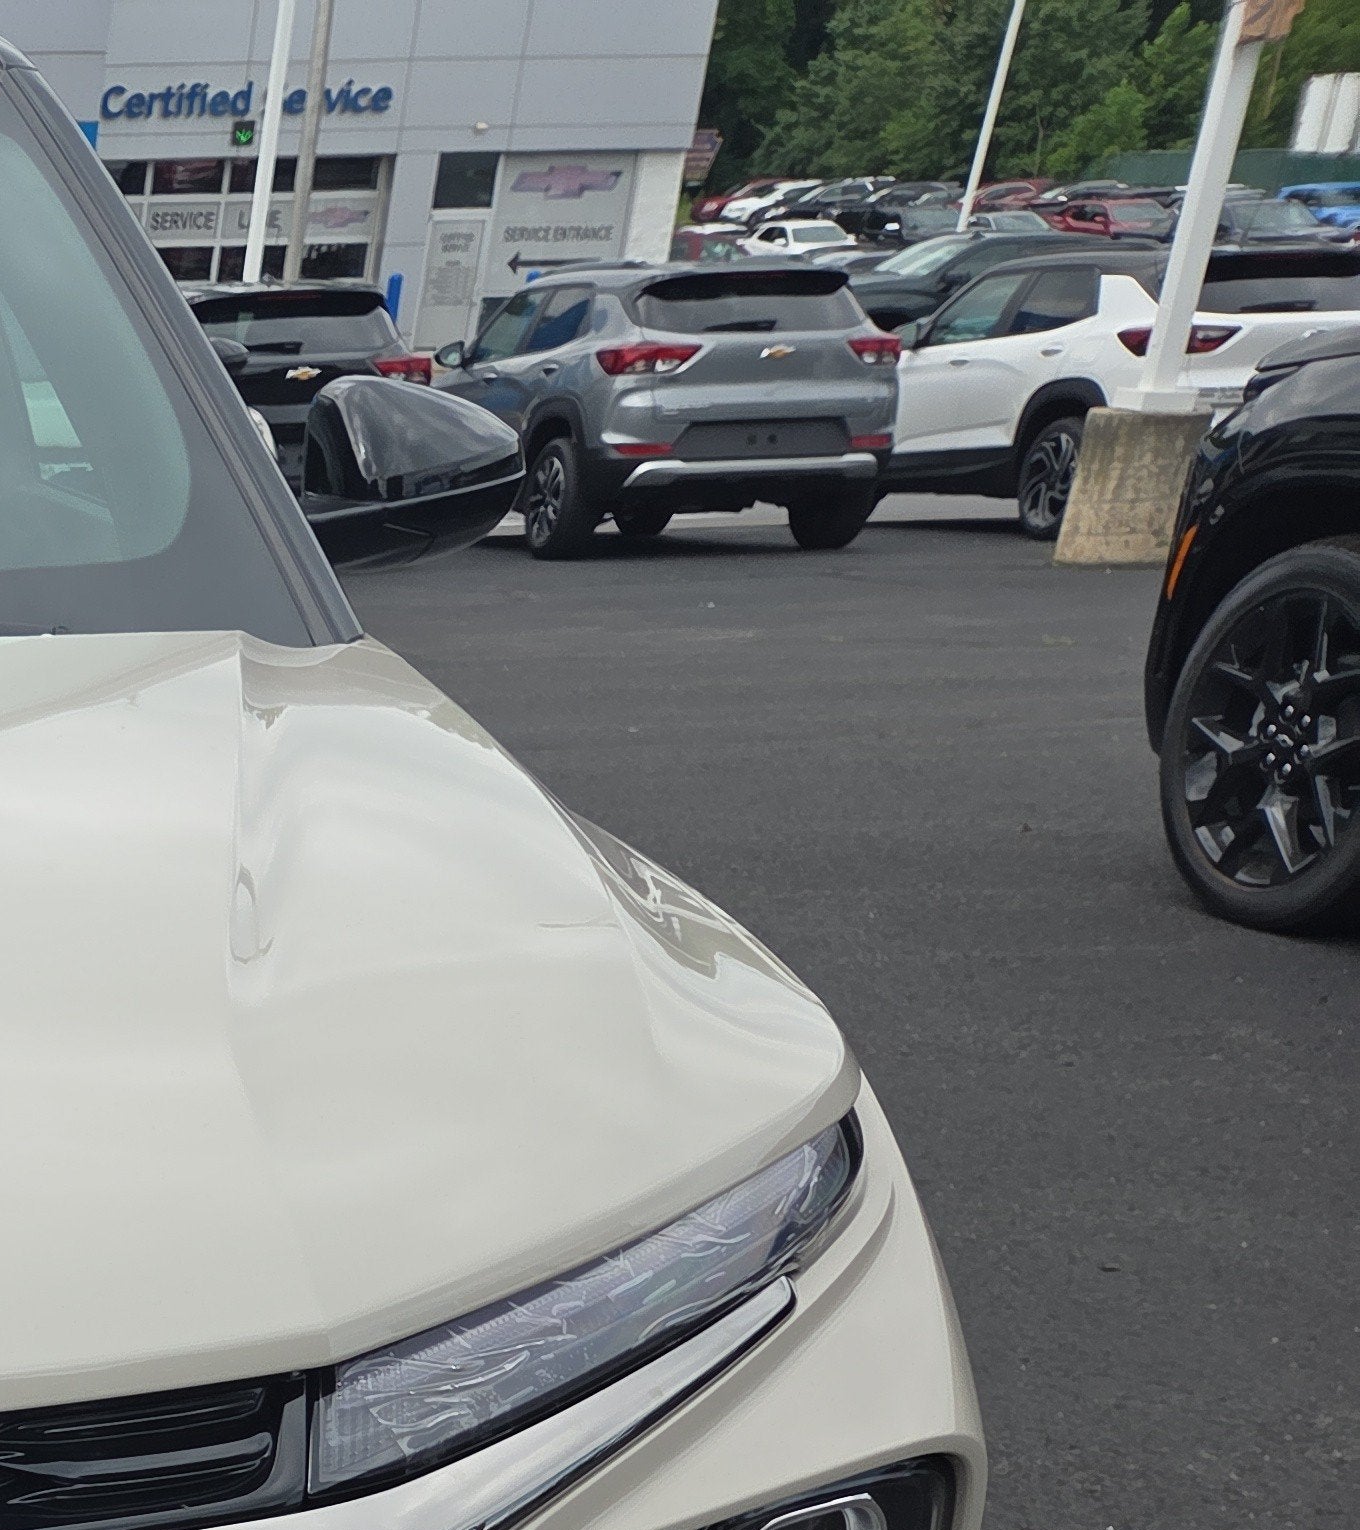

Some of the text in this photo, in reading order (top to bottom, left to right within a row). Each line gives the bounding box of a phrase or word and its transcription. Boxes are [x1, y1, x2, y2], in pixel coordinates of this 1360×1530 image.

[100, 78, 394, 119] Certified evice
[150, 209, 282, 231] SERVICE LE
